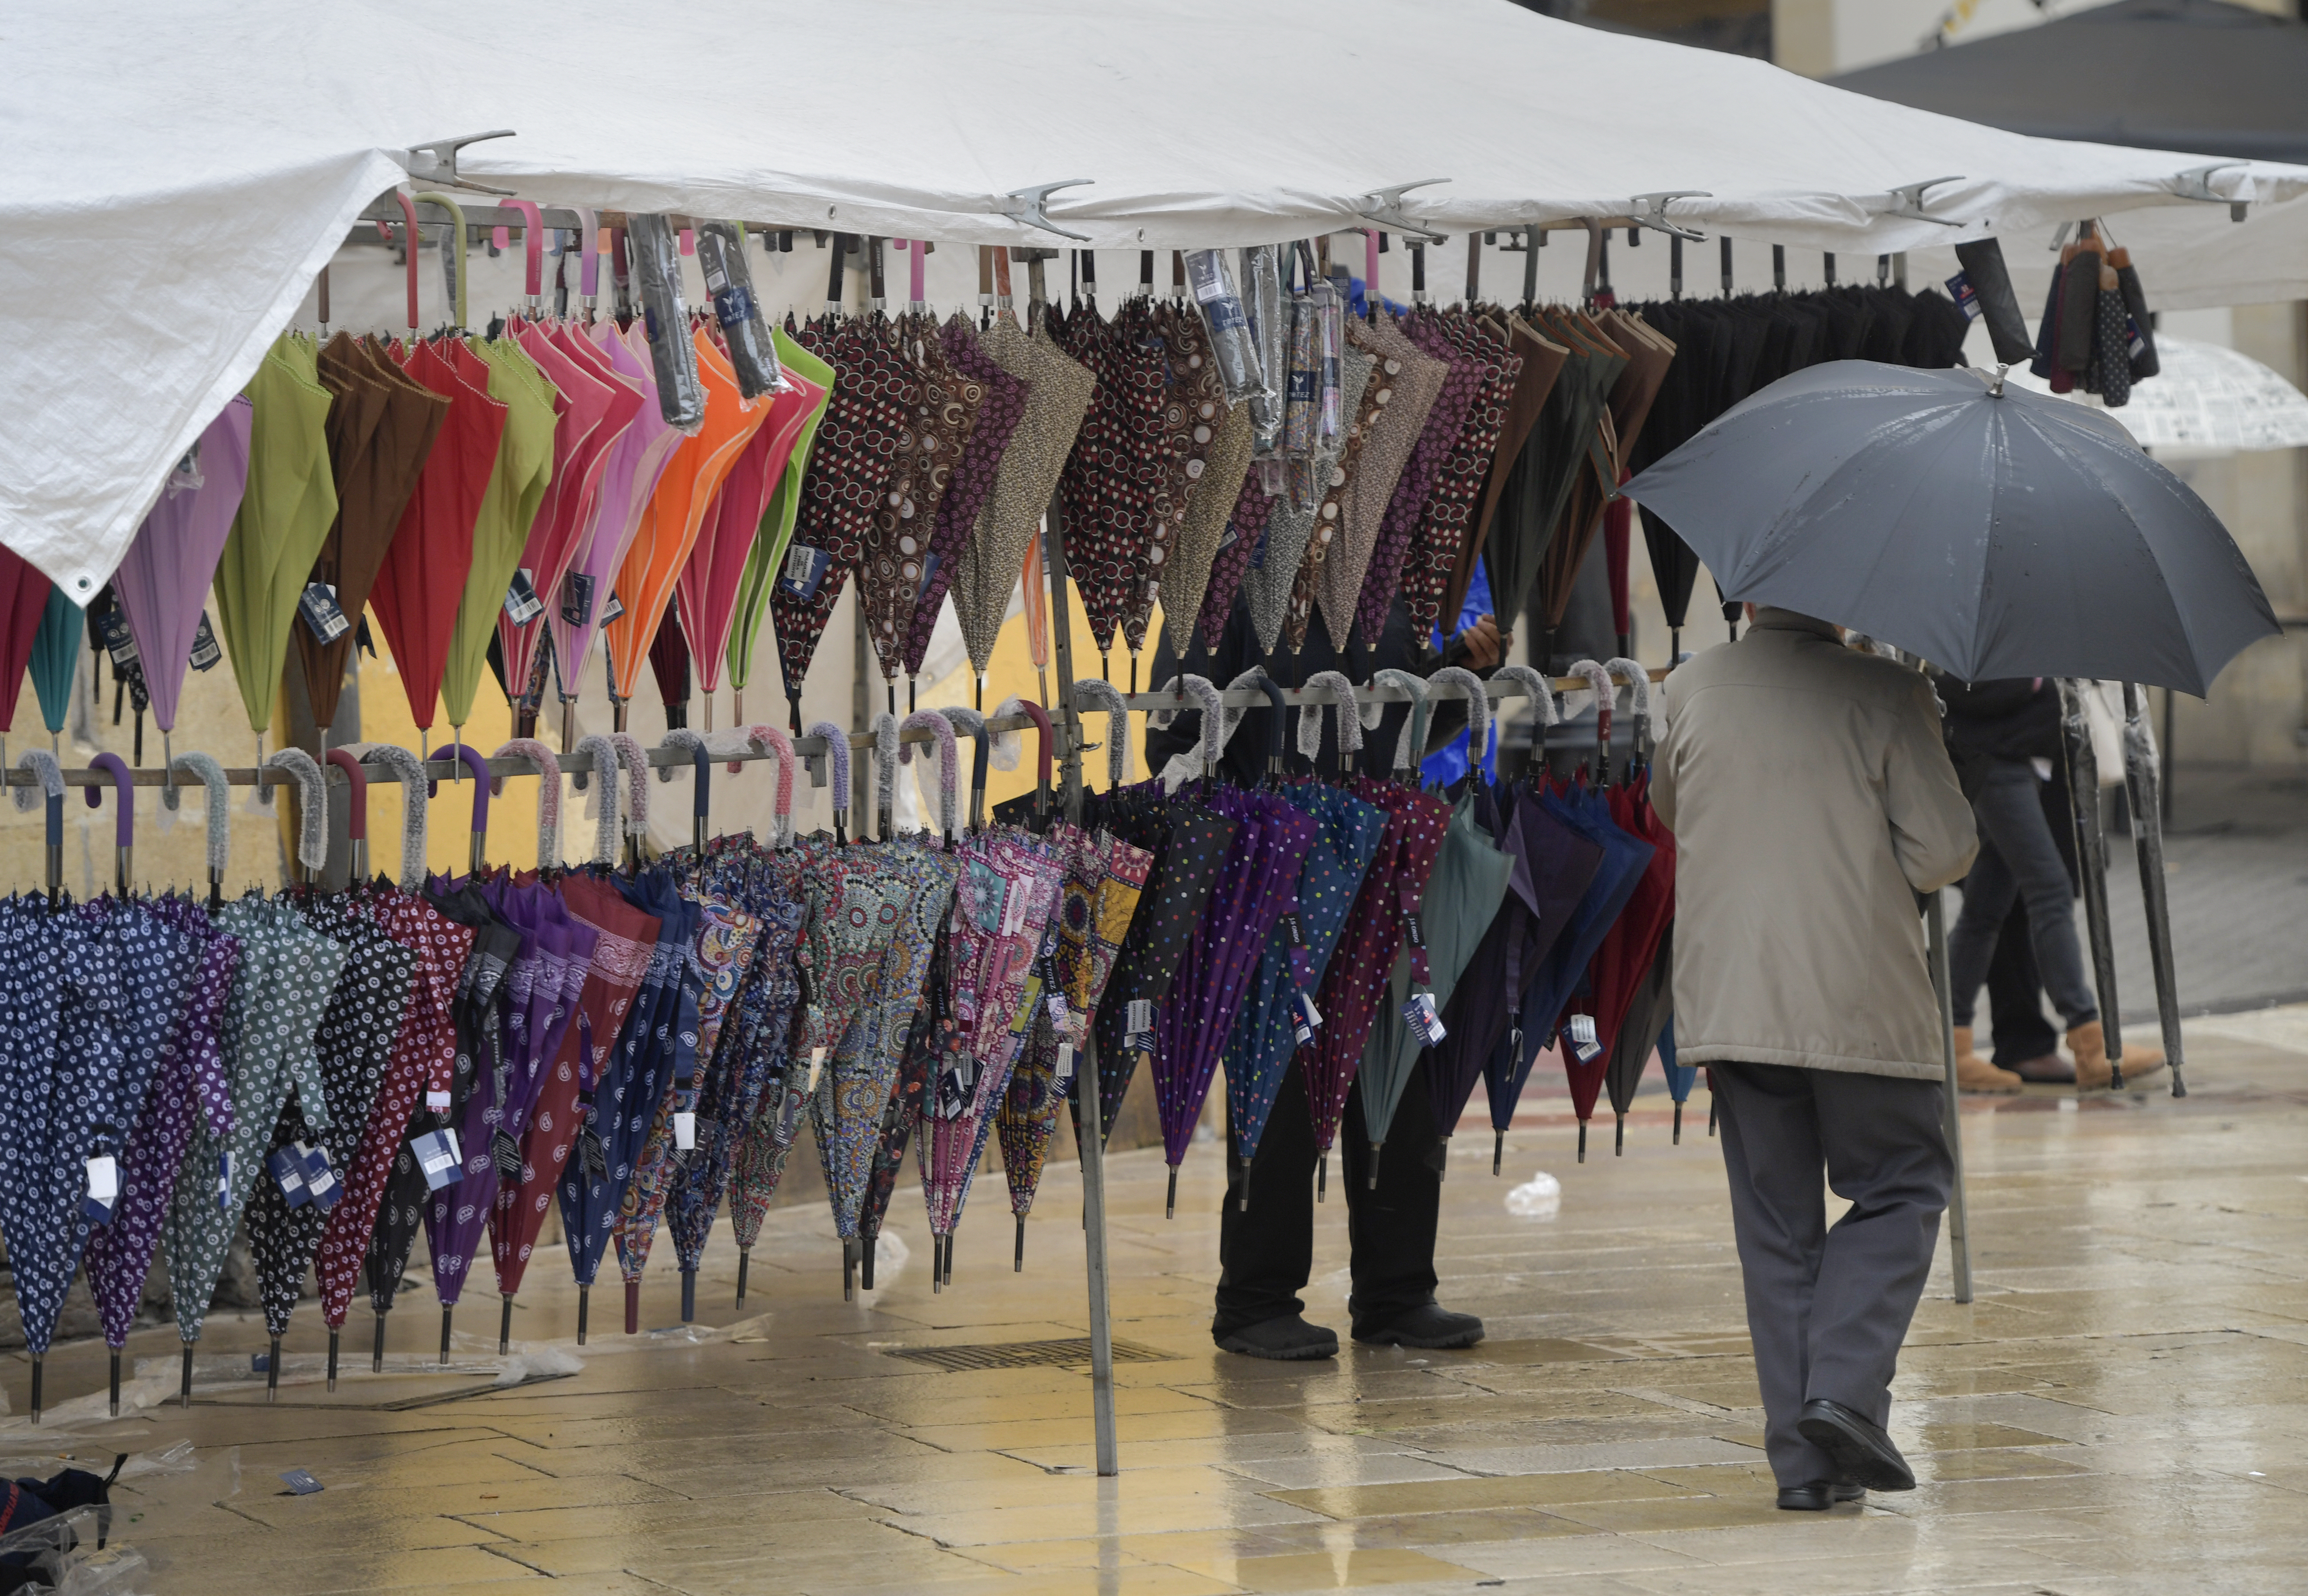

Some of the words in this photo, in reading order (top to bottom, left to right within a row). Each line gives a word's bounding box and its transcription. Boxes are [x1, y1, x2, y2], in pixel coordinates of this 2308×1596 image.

[1222, 316, 1243, 326] TOTEZ
[802, 551, 810, 578] PARAGUAS
[1291, 925, 1300, 943] ONDO
[1411, 925, 1419, 943] ONDO
[1046, 967, 1056, 990] TOTEZ
[938, 994, 947, 1016] TOTEZ
